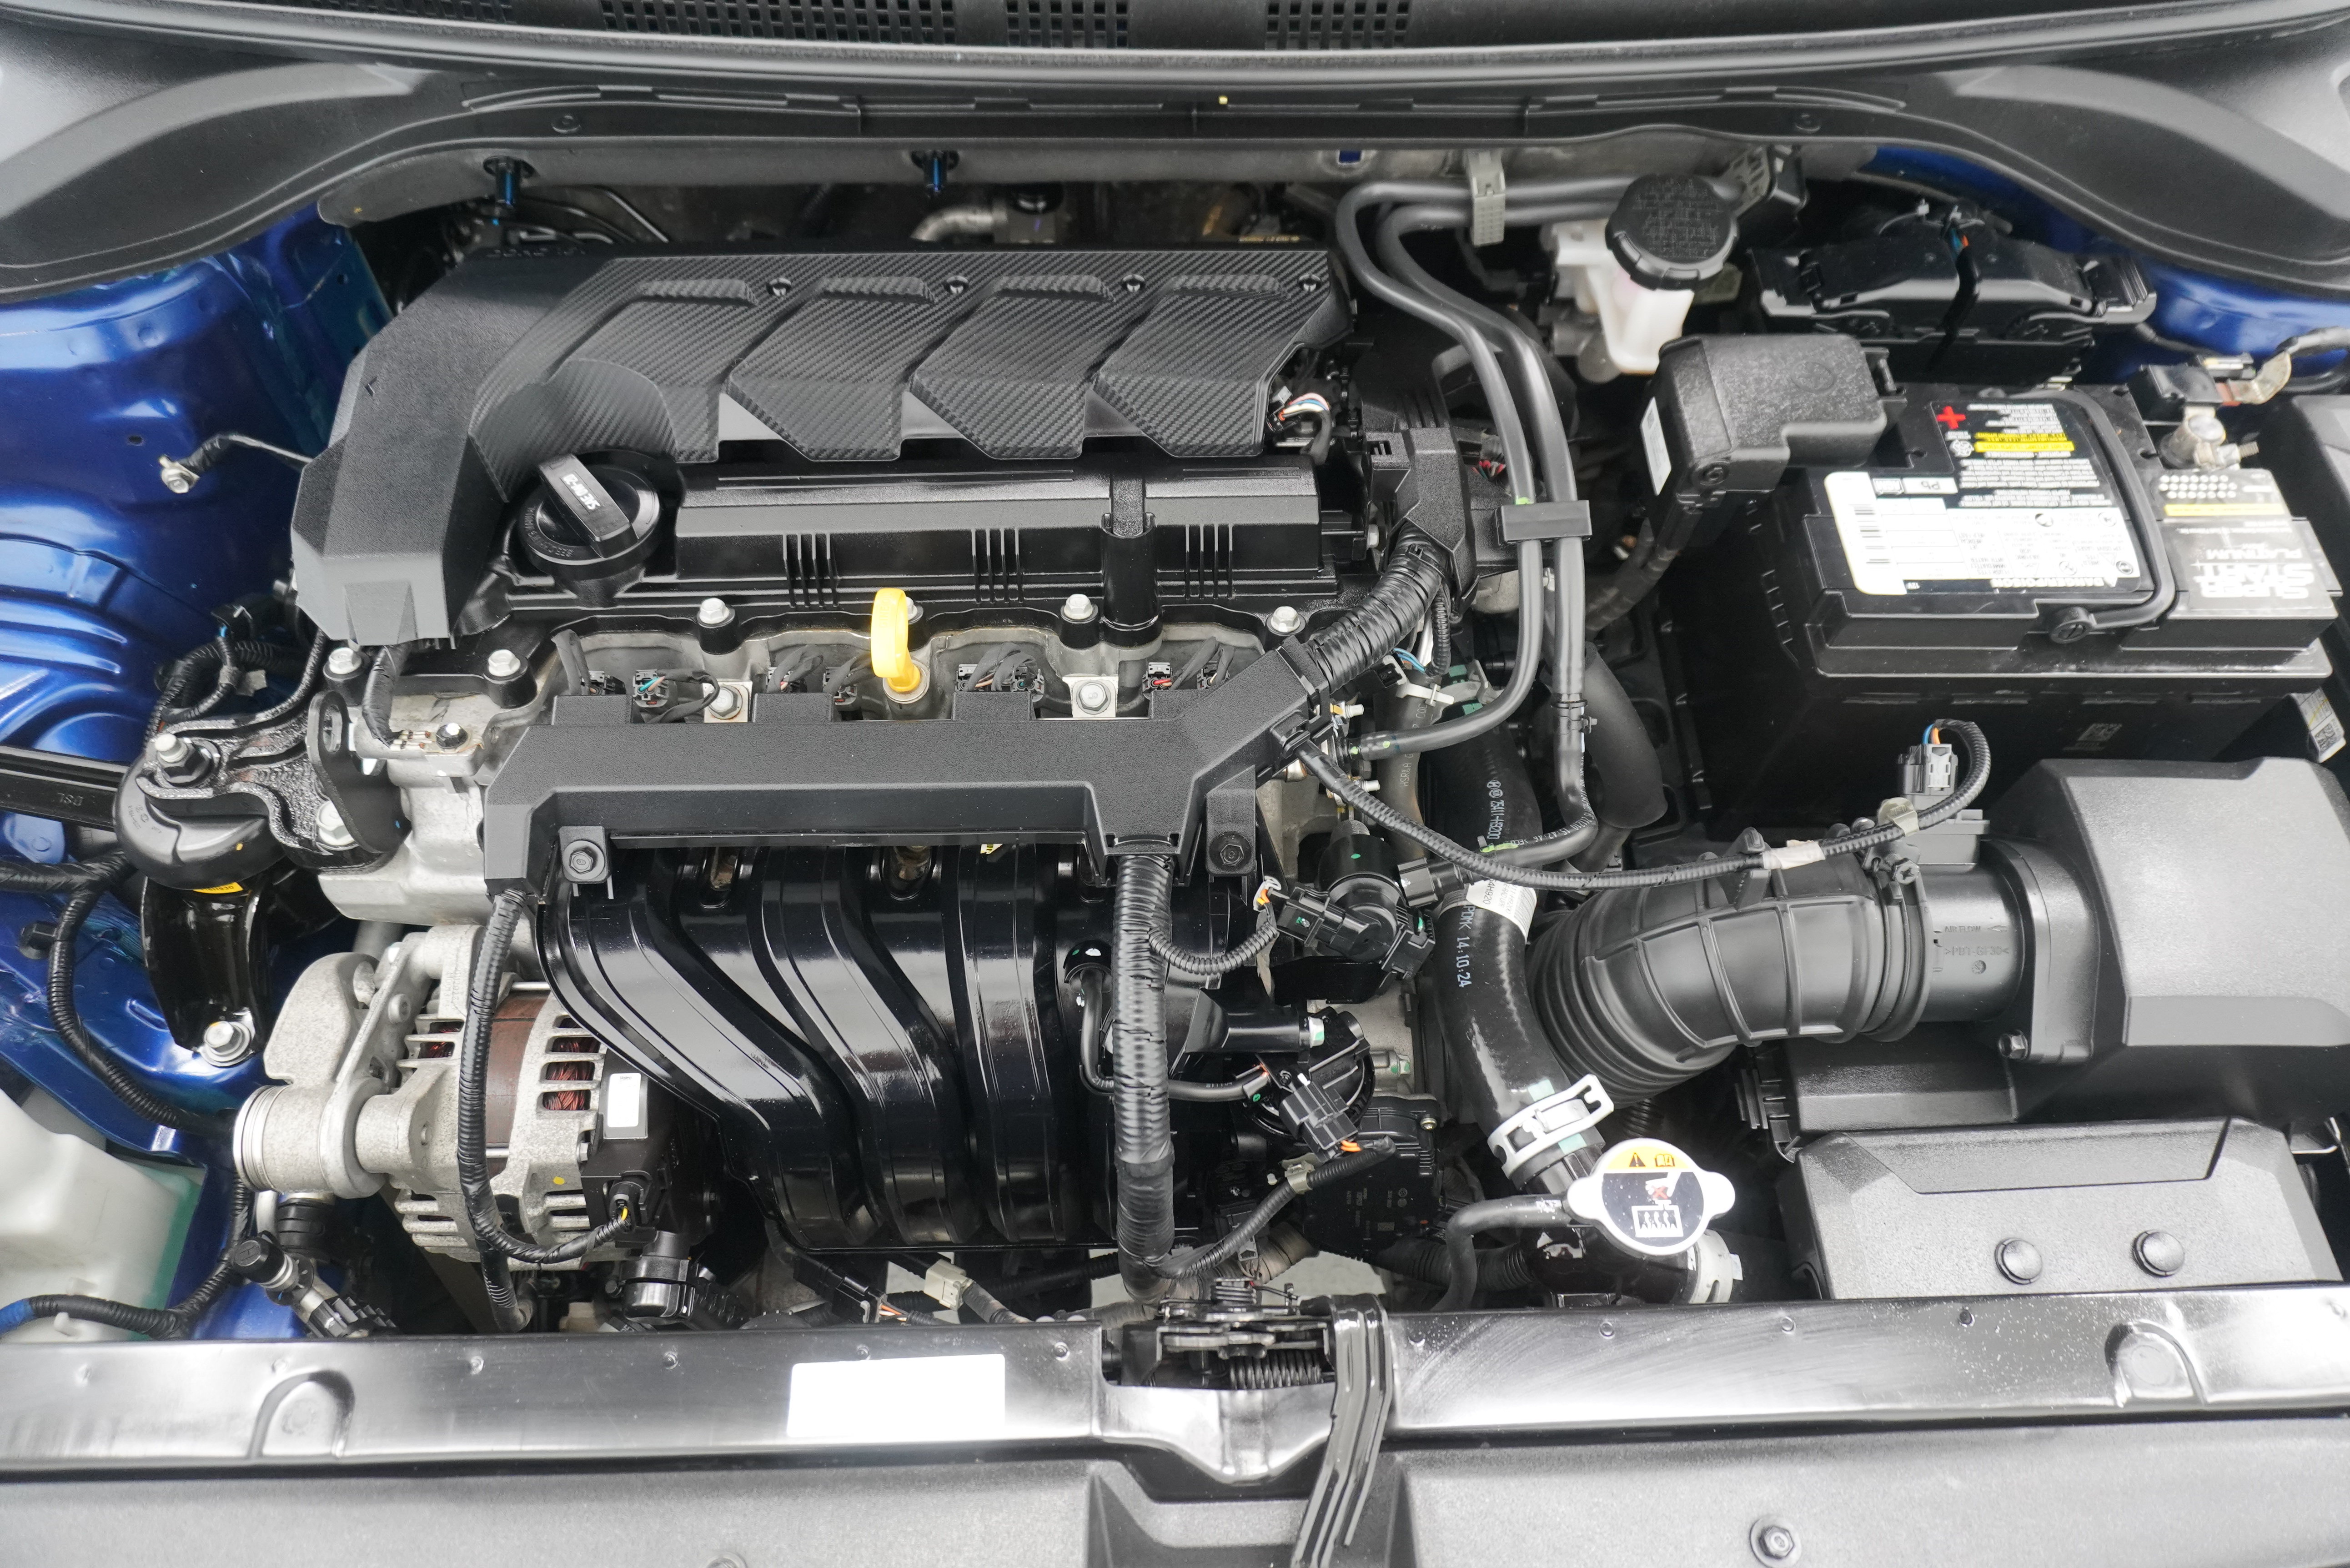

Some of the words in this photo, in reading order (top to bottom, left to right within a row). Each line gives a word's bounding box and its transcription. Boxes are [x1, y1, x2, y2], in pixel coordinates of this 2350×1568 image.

[1921, 480, 1941, 491] Pb
[580, 494, 601, 510] SAE
[2205, 548, 2302, 560] PLATINUM
[1992, 578, 2104, 587] DANGER/POISON
[2193, 563, 2315, 587] START
[2199, 583, 2309, 599] SUPER
[1456, 935, 1473, 988] 14:10:24
